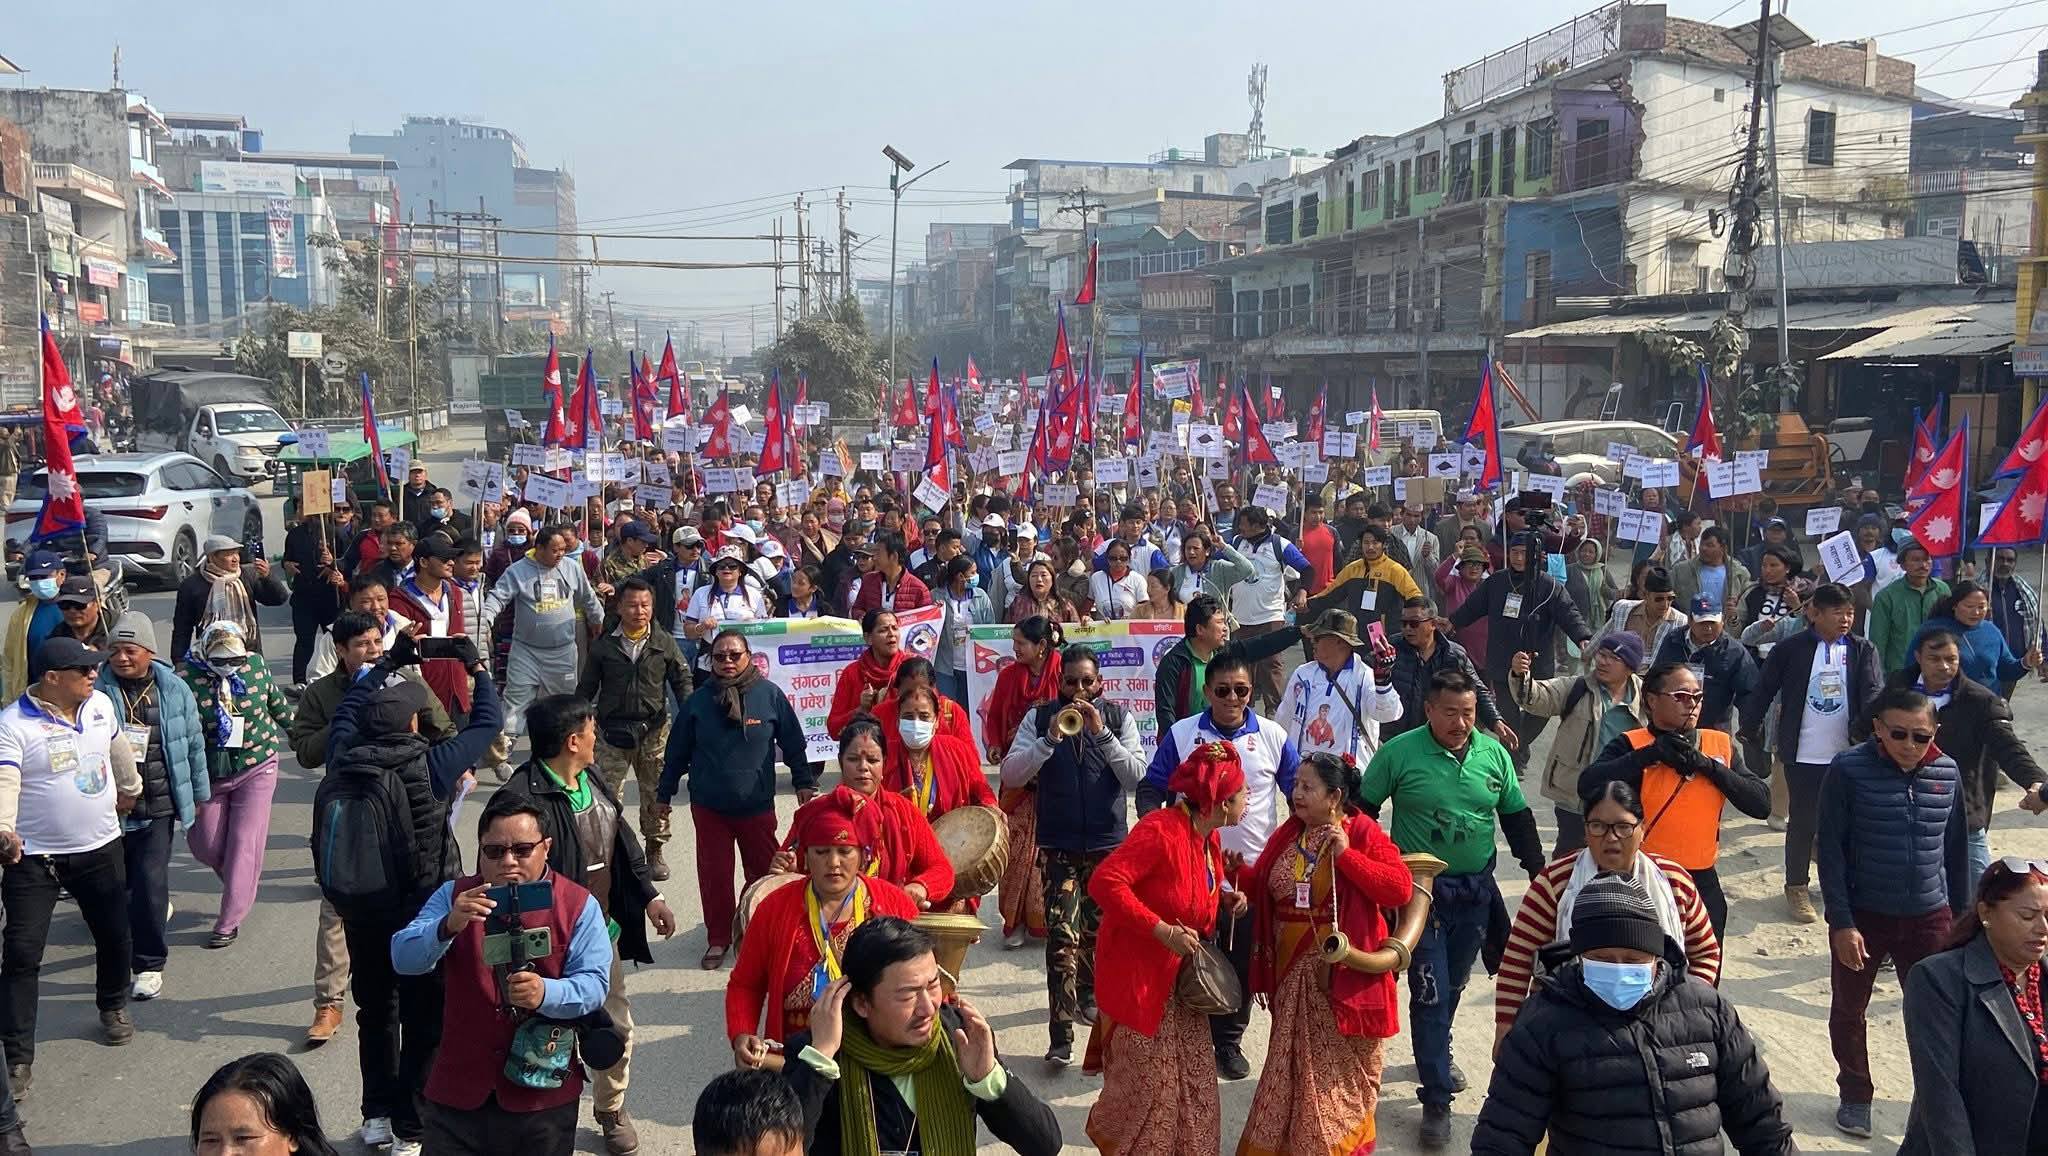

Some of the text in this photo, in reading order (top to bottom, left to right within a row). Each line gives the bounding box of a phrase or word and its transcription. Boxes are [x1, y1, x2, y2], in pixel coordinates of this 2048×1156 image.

[791, 674, 831, 690] संगठन
[1126, 678, 1149, 691] सभा
[800, 692, 826, 711] प्रवेश
